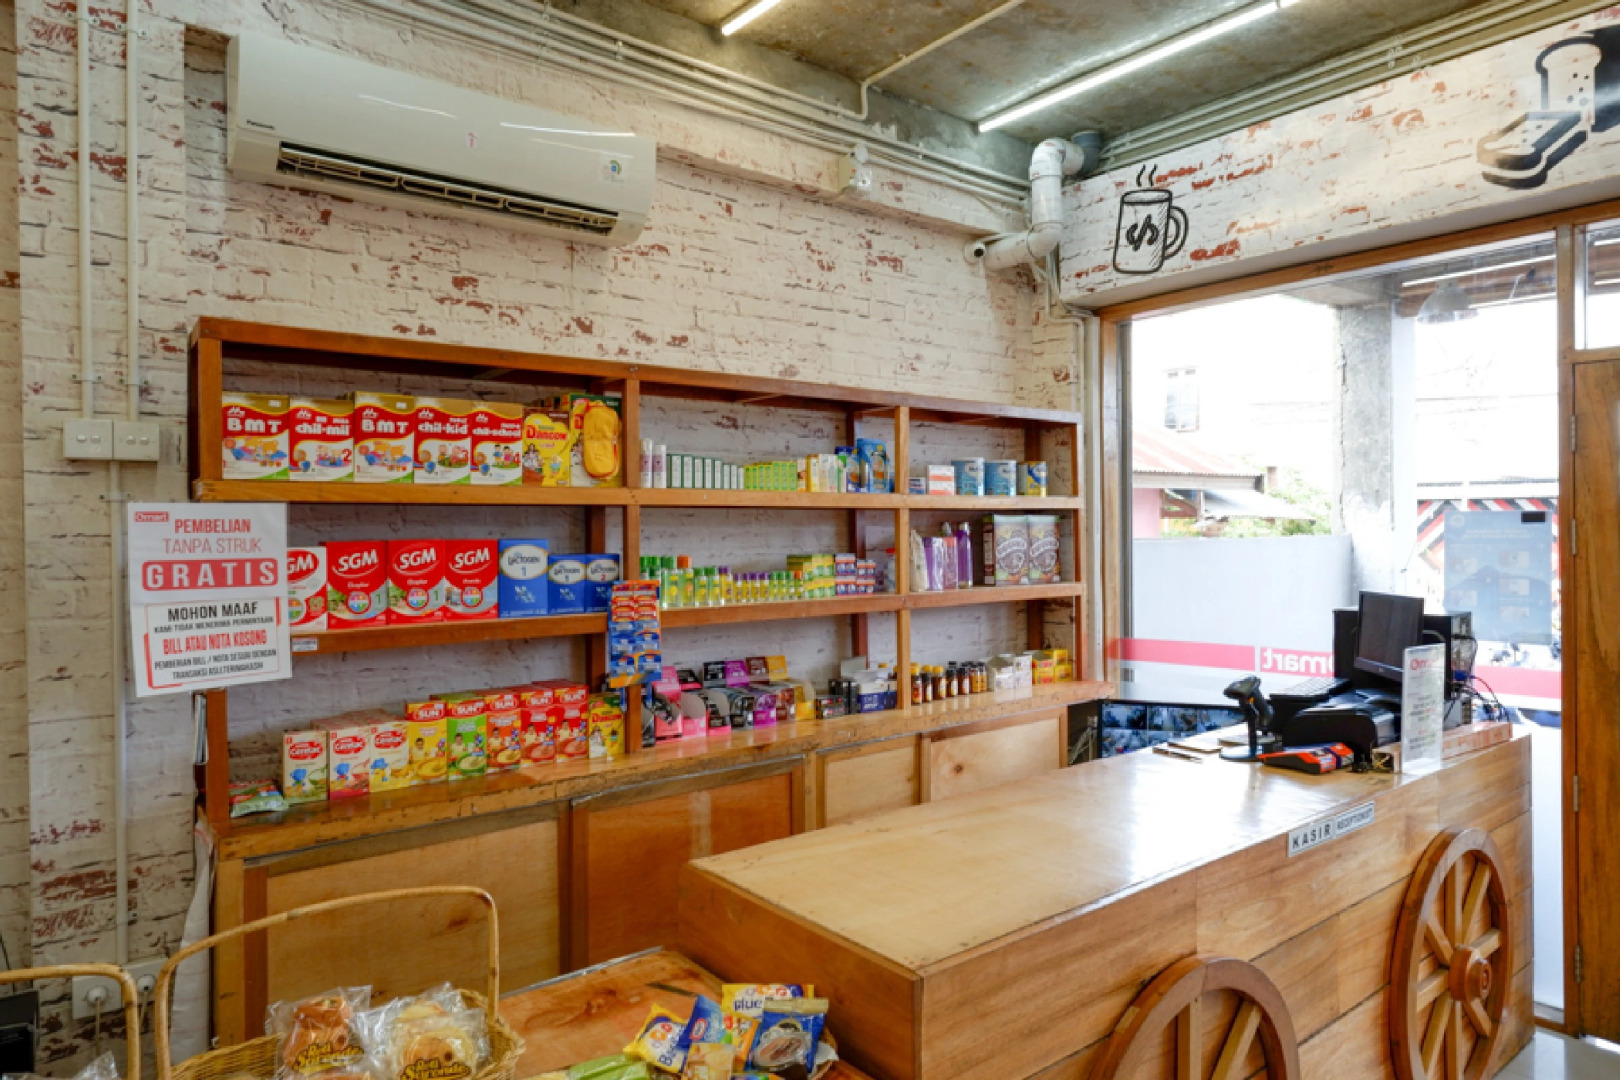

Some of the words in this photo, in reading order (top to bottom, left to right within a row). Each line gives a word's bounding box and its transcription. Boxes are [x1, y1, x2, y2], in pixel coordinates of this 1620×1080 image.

[175, 518, 251, 533] PEMBELIAN
[163, 538, 212, 554] TANPA
[216, 537, 261, 553] STRUK
[287, 553, 314, 574] GM
[338, 549, 379, 572] SGM
[400, 547, 437, 570] SGM
[455, 547, 490, 568] SGM
[146, 561, 275, 588] GRATIS
[168, 605, 217, 622] MOHON
[222, 601, 258, 616] MAAF
[163, 638, 183, 655] BILL
[185, 635, 207, 652] ATAU
[209, 633, 231, 649] NOTA
[233, 629, 267, 647] KOSONG
[1293, 824, 1330, 850] KASIR
